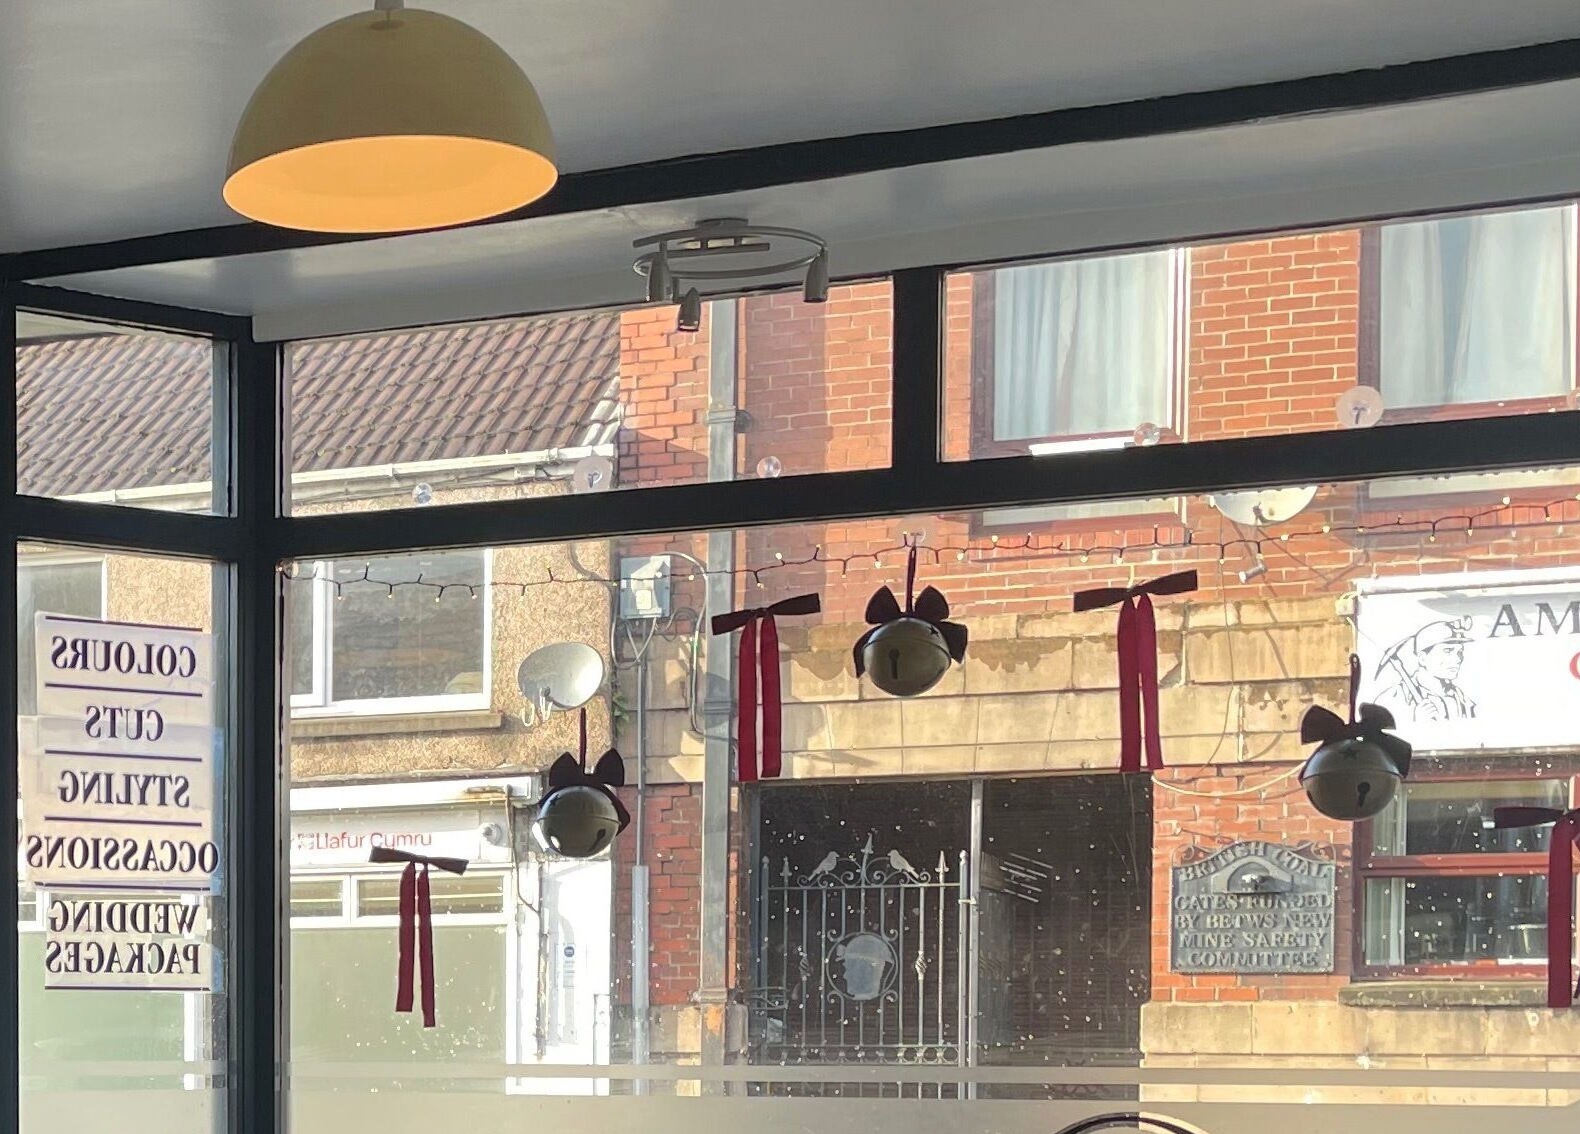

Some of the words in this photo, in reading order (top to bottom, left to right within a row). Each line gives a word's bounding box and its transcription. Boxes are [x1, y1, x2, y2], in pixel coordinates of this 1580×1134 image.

[370, 832, 432, 850] Cymru
[1180, 841, 1266, 880] BRITISH
[1274, 848, 1329, 878] COAL
[1174, 913, 1199, 930] BY
[1283, 912, 1332, 930] NEW
[1179, 931, 1234, 948] MINE
[1243, 931, 1327, 949] SAFETY
[1188, 950, 1318, 968] COMMITTEE
